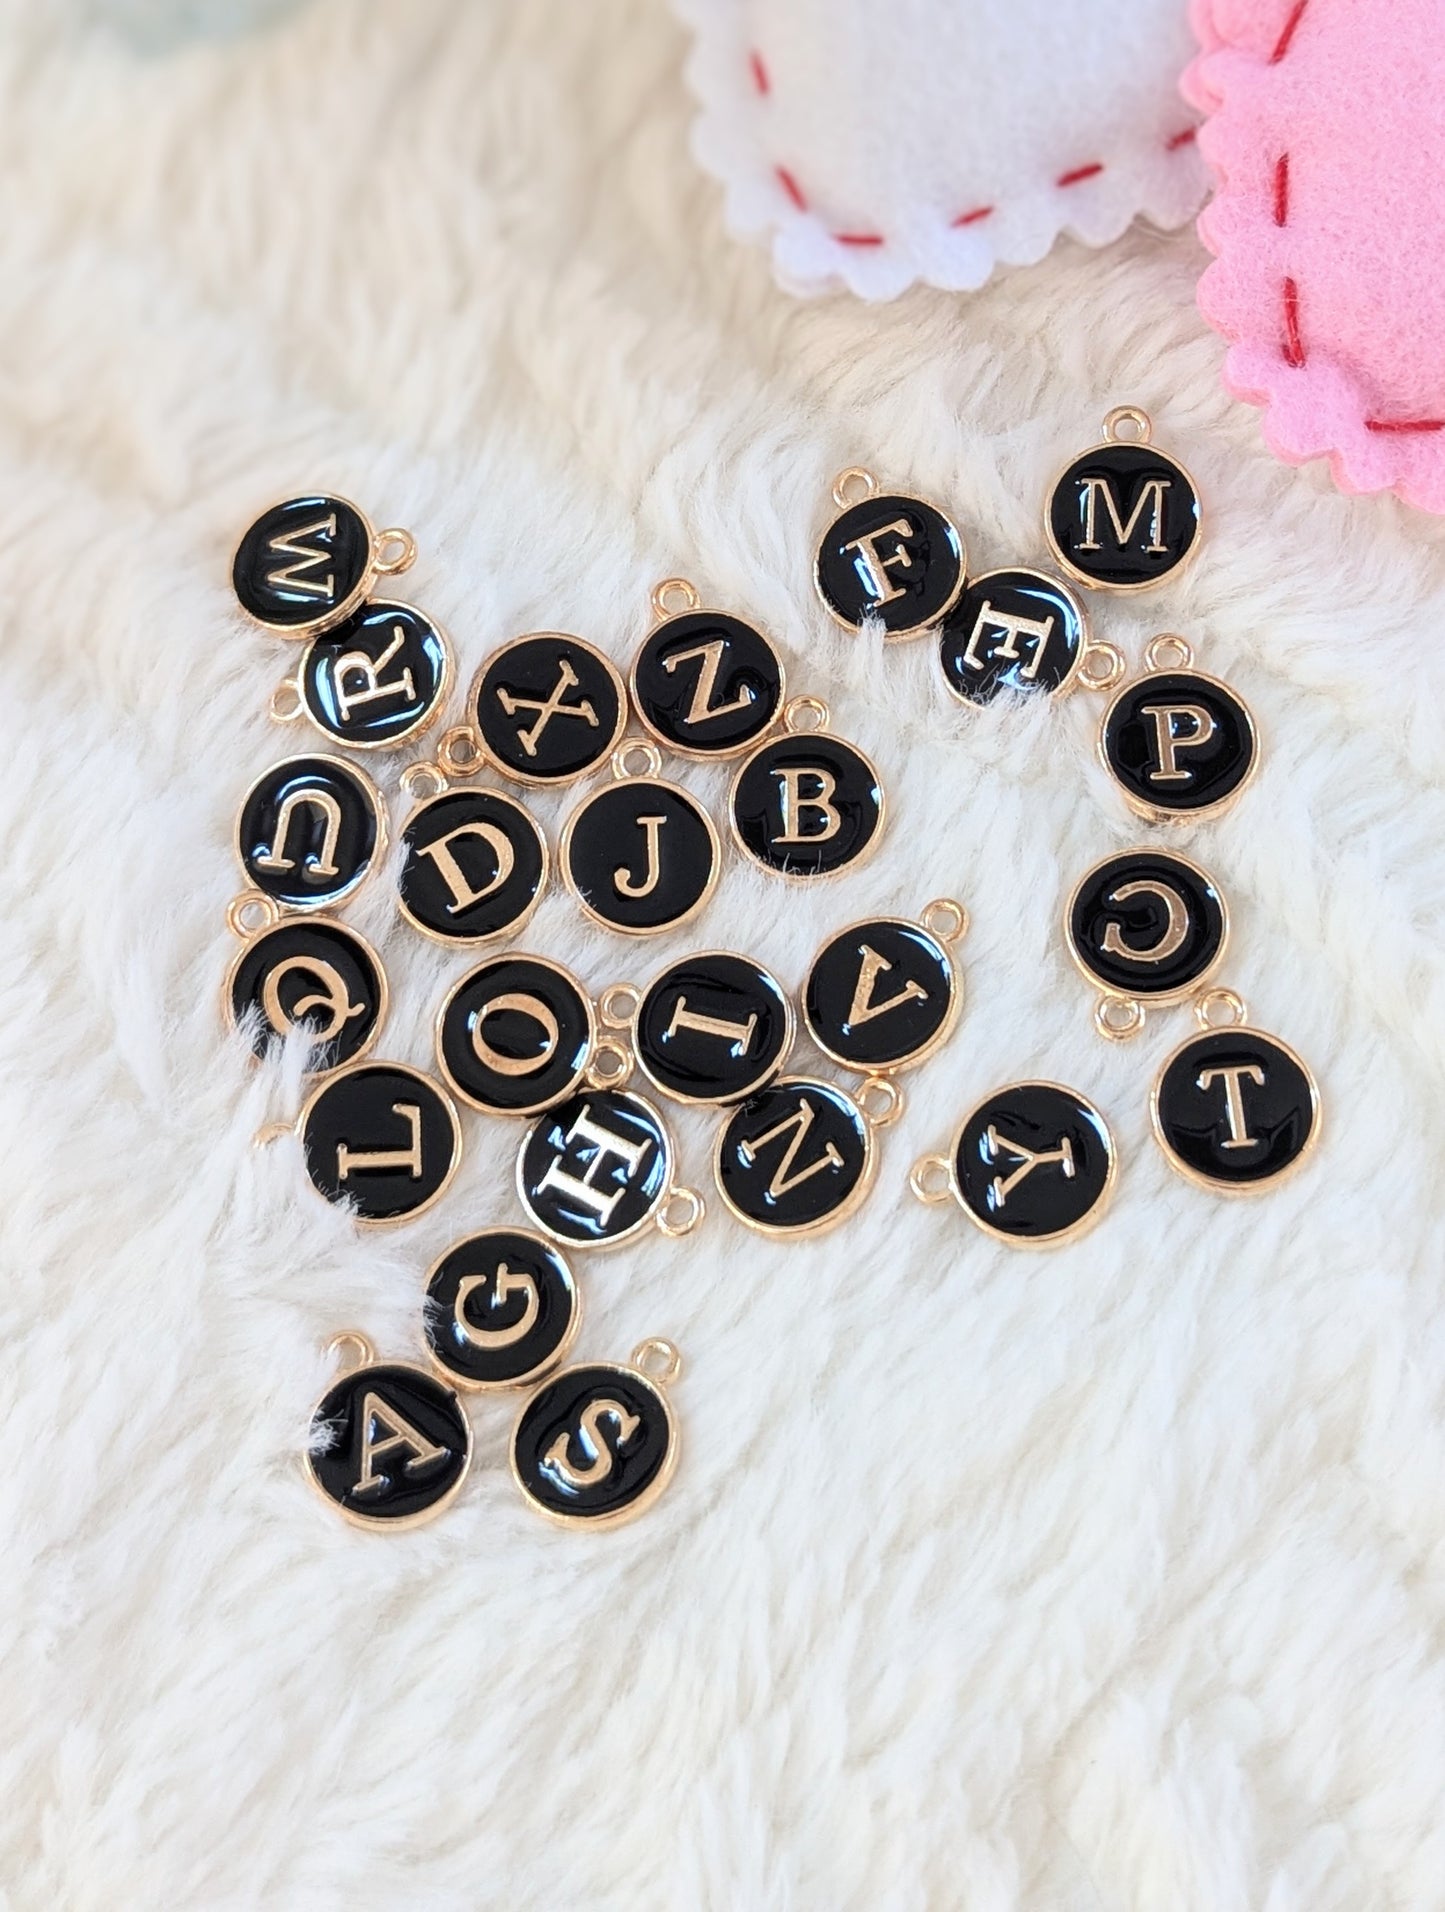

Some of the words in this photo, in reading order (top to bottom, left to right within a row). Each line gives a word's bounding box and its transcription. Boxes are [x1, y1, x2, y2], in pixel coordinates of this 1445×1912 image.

[267, 513, 337, 597] W
[1078, 478, 1171, 552] M
[845, 518, 914, 608] F
[334, 625, 416, 721] R
[963, 600, 1054, 679] E
[496, 659, 599, 756] X
[662, 640, 752, 724] Z
[1141, 704, 1213, 780] P
[257, 788, 341, 876] U
[771, 767, 842, 844] B
[416, 822, 514, 913] D
[614, 816, 667, 897] J
[1101, 880, 1190, 963] C
[263, 955, 366, 1044] Q
[668, 996, 757, 1056] I
[848, 944, 928, 1027] V
[472, 992, 559, 1076] O
[337, 1103, 422, 1180] L
[741, 1098, 844, 1198] N
[1199, 1065, 1264, 1149] T
[537, 1104, 653, 1229] H
[986, 1125, 1075, 1207] Y
[455, 1262, 539, 1350] G
[352, 1392, 451, 1495] A
[545, 1399, 640, 1486] S
